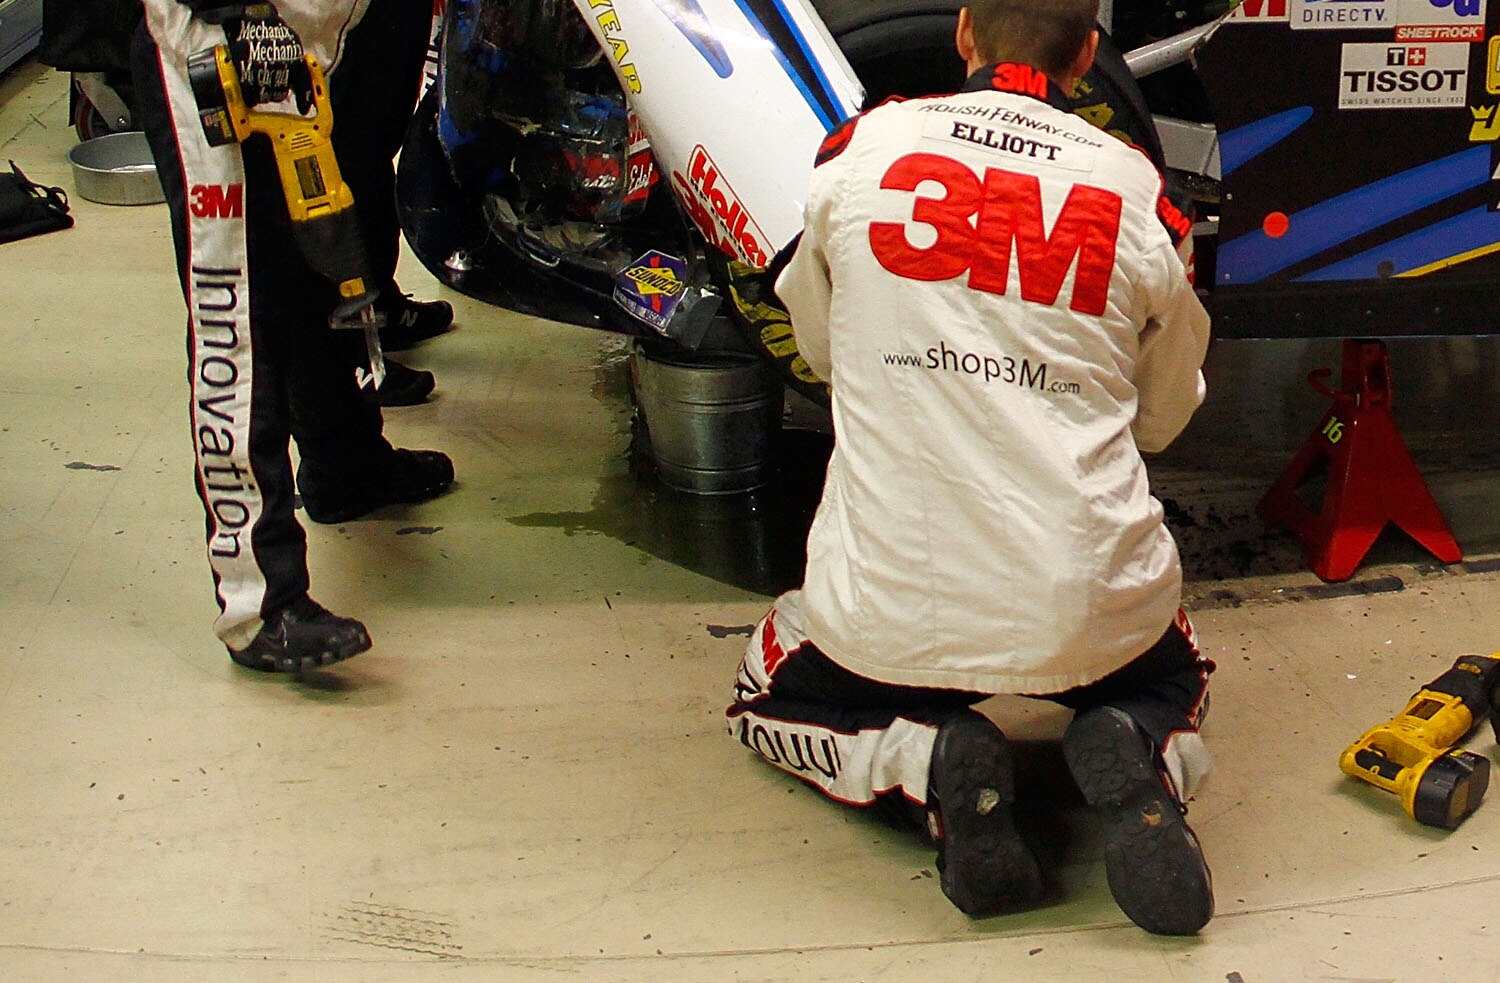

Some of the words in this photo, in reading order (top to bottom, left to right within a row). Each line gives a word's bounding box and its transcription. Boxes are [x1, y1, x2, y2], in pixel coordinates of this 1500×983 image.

[1303, 8, 1386, 23] DIRECTV
[1396, 26, 1480, 39] SHEETROCK
[991, 61, 1048, 100] 3M
[1343, 69, 1466, 93] TISSOT
[950, 120, 1062, 161] ELLIOTT
[190, 183, 243, 219] 3M
[868, 151, 1123, 317] 3M
[628, 267, 682, 295] SUNOCO
[883, 340, 1081, 395] www.shop3M.com
[191, 265, 255, 558] Innovation
[1321, 416, 1346, 445] 16
